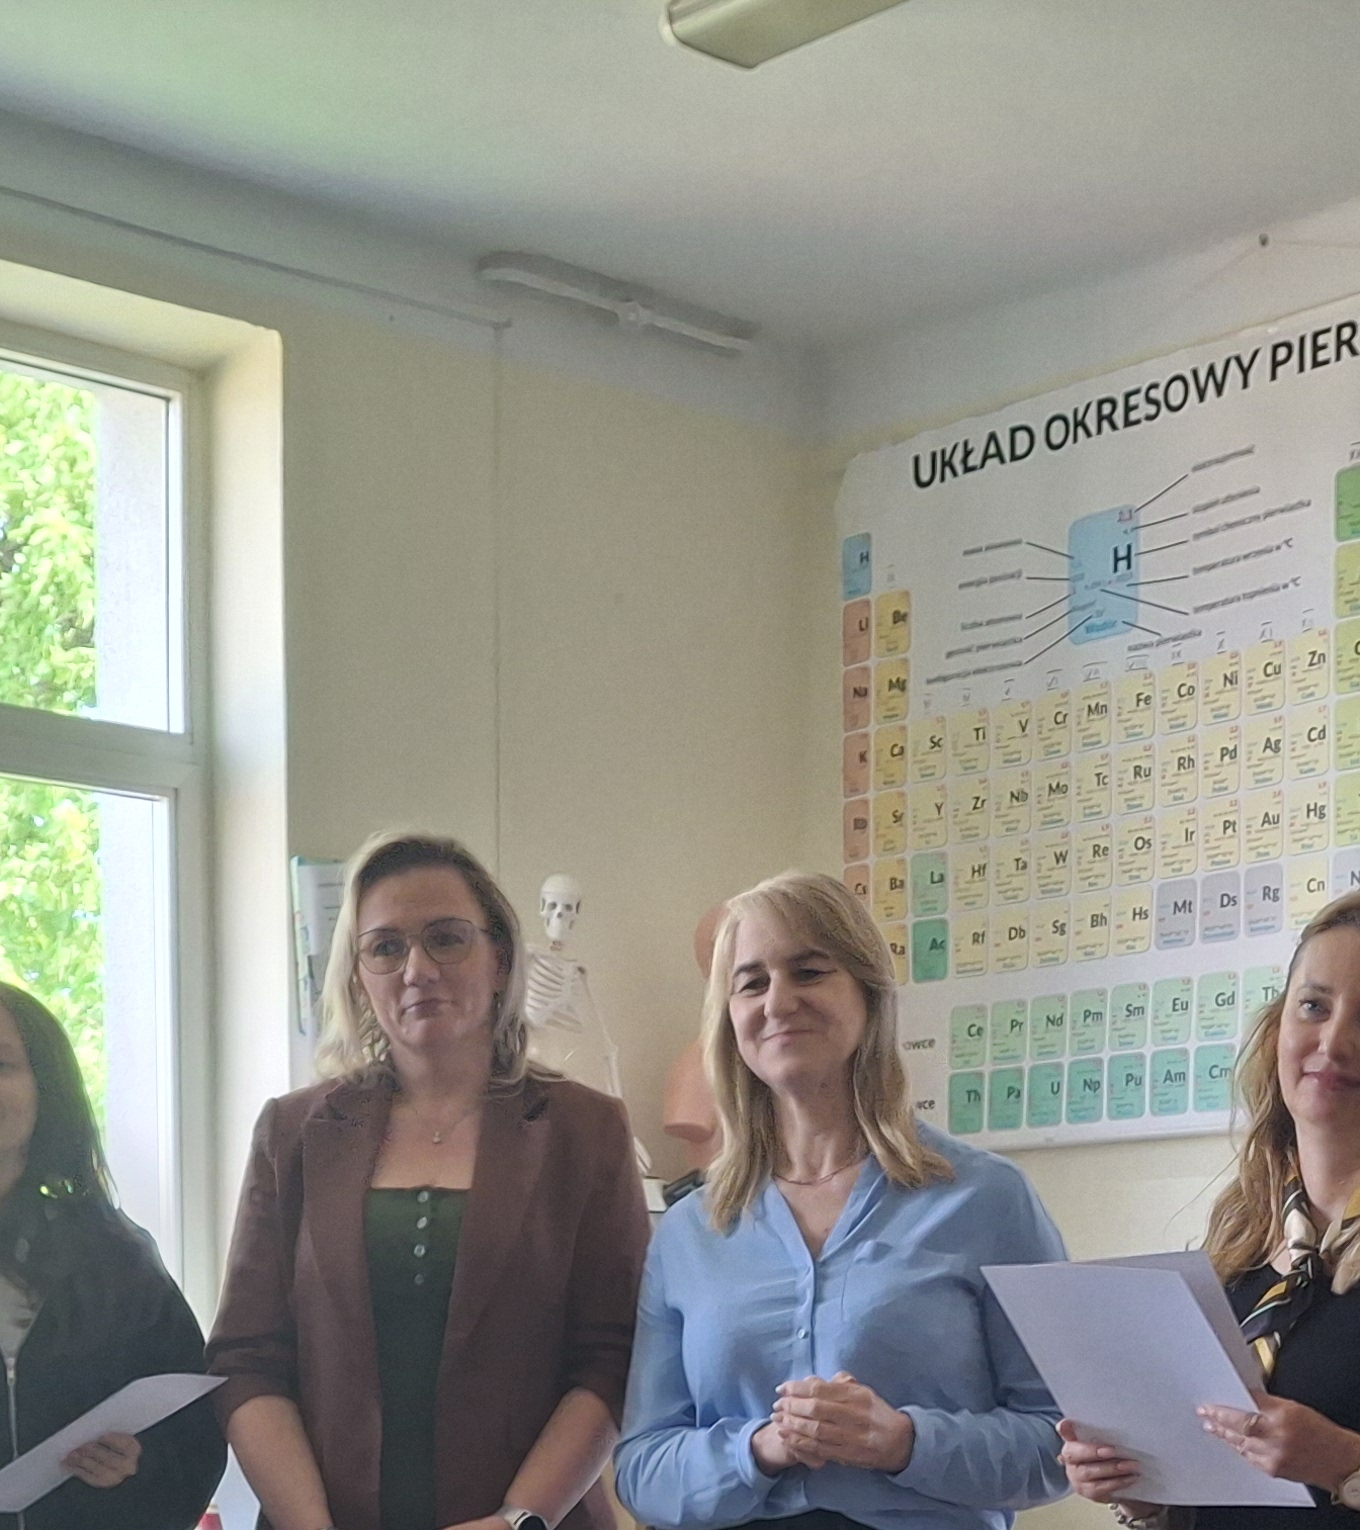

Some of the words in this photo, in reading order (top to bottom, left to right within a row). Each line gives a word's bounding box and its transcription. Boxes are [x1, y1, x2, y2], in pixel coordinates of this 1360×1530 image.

[912, 424, 1036, 488] UKŁAD
[1044, 346, 1262, 451] OKRESOWY
[1113, 543, 1132, 573] H
[1308, 650, 1326, 667] Zn
[1263, 661, 1282, 678] Cu
[1223, 670, 1238, 688] Ni
[1177, 683, 1195, 698] Co
[1135, 692, 1152, 708] Fe
[1087, 701, 1108, 718] Mn
[1018, 719, 1029, 732] V
[1054, 711, 1068, 726] Cr
[1307, 724, 1326, 743] Cd
[929, 735, 943, 749] Sc
[1262, 736, 1282, 754] Ag
[1220, 744, 1238, 762] Pd
[1177, 755, 1195, 771] Rh
[1095, 772, 1108, 786] Tc
[1133, 765, 1151, 780] Ru
[1009, 789, 1029, 804] Nb
[1048, 781, 1069, 797] Mo
[935, 803, 944, 816] Y
[972, 796, 987, 811] Zr
[1306, 803, 1327, 820] Hg
[1261, 812, 1280, 827] Au
[1184, 828, 1195, 842] Ir
[1222, 820, 1237, 835] Pt
[1134, 836, 1152, 850] Os
[1054, 850, 1069, 865] W
[1092, 844, 1109, 859] Re
[971, 863, 987, 878] Hf
[1014, 858, 1028, 871] Ta
[890, 877, 905, 890] Ba
[930, 871, 944, 885] La
[1306, 878, 1325, 893] Cn
[1220, 893, 1237, 908] Ds
[1262, 886, 1280, 903] Rg
[1132, 906, 1149, 921] Hs
[1172, 900, 1193, 916] Mt
[1052, 919, 1067, 936] Sg
[1090, 913, 1107, 928] Bh
[972, 931, 985, 946] Rf
[1008, 925, 1026, 941] Db
[929, 937, 945, 951] Ac
[1172, 997, 1189, 1012] Eu
[1214, 991, 1235, 1007] Gd
[1083, 1009, 1103, 1023] Pm
[1125, 1003, 1145, 1017] Sm
[1010, 1019, 1023, 1033] Pr
[1046, 1013, 1064, 1028] Nd
[968, 1023, 983, 1037] Ce
[1125, 1073, 1142, 1087] Pu
[1163, 1069, 1186, 1084] Am
[1051, 1081, 1060, 1095] U
[1083, 1078, 1101, 1093] Np
